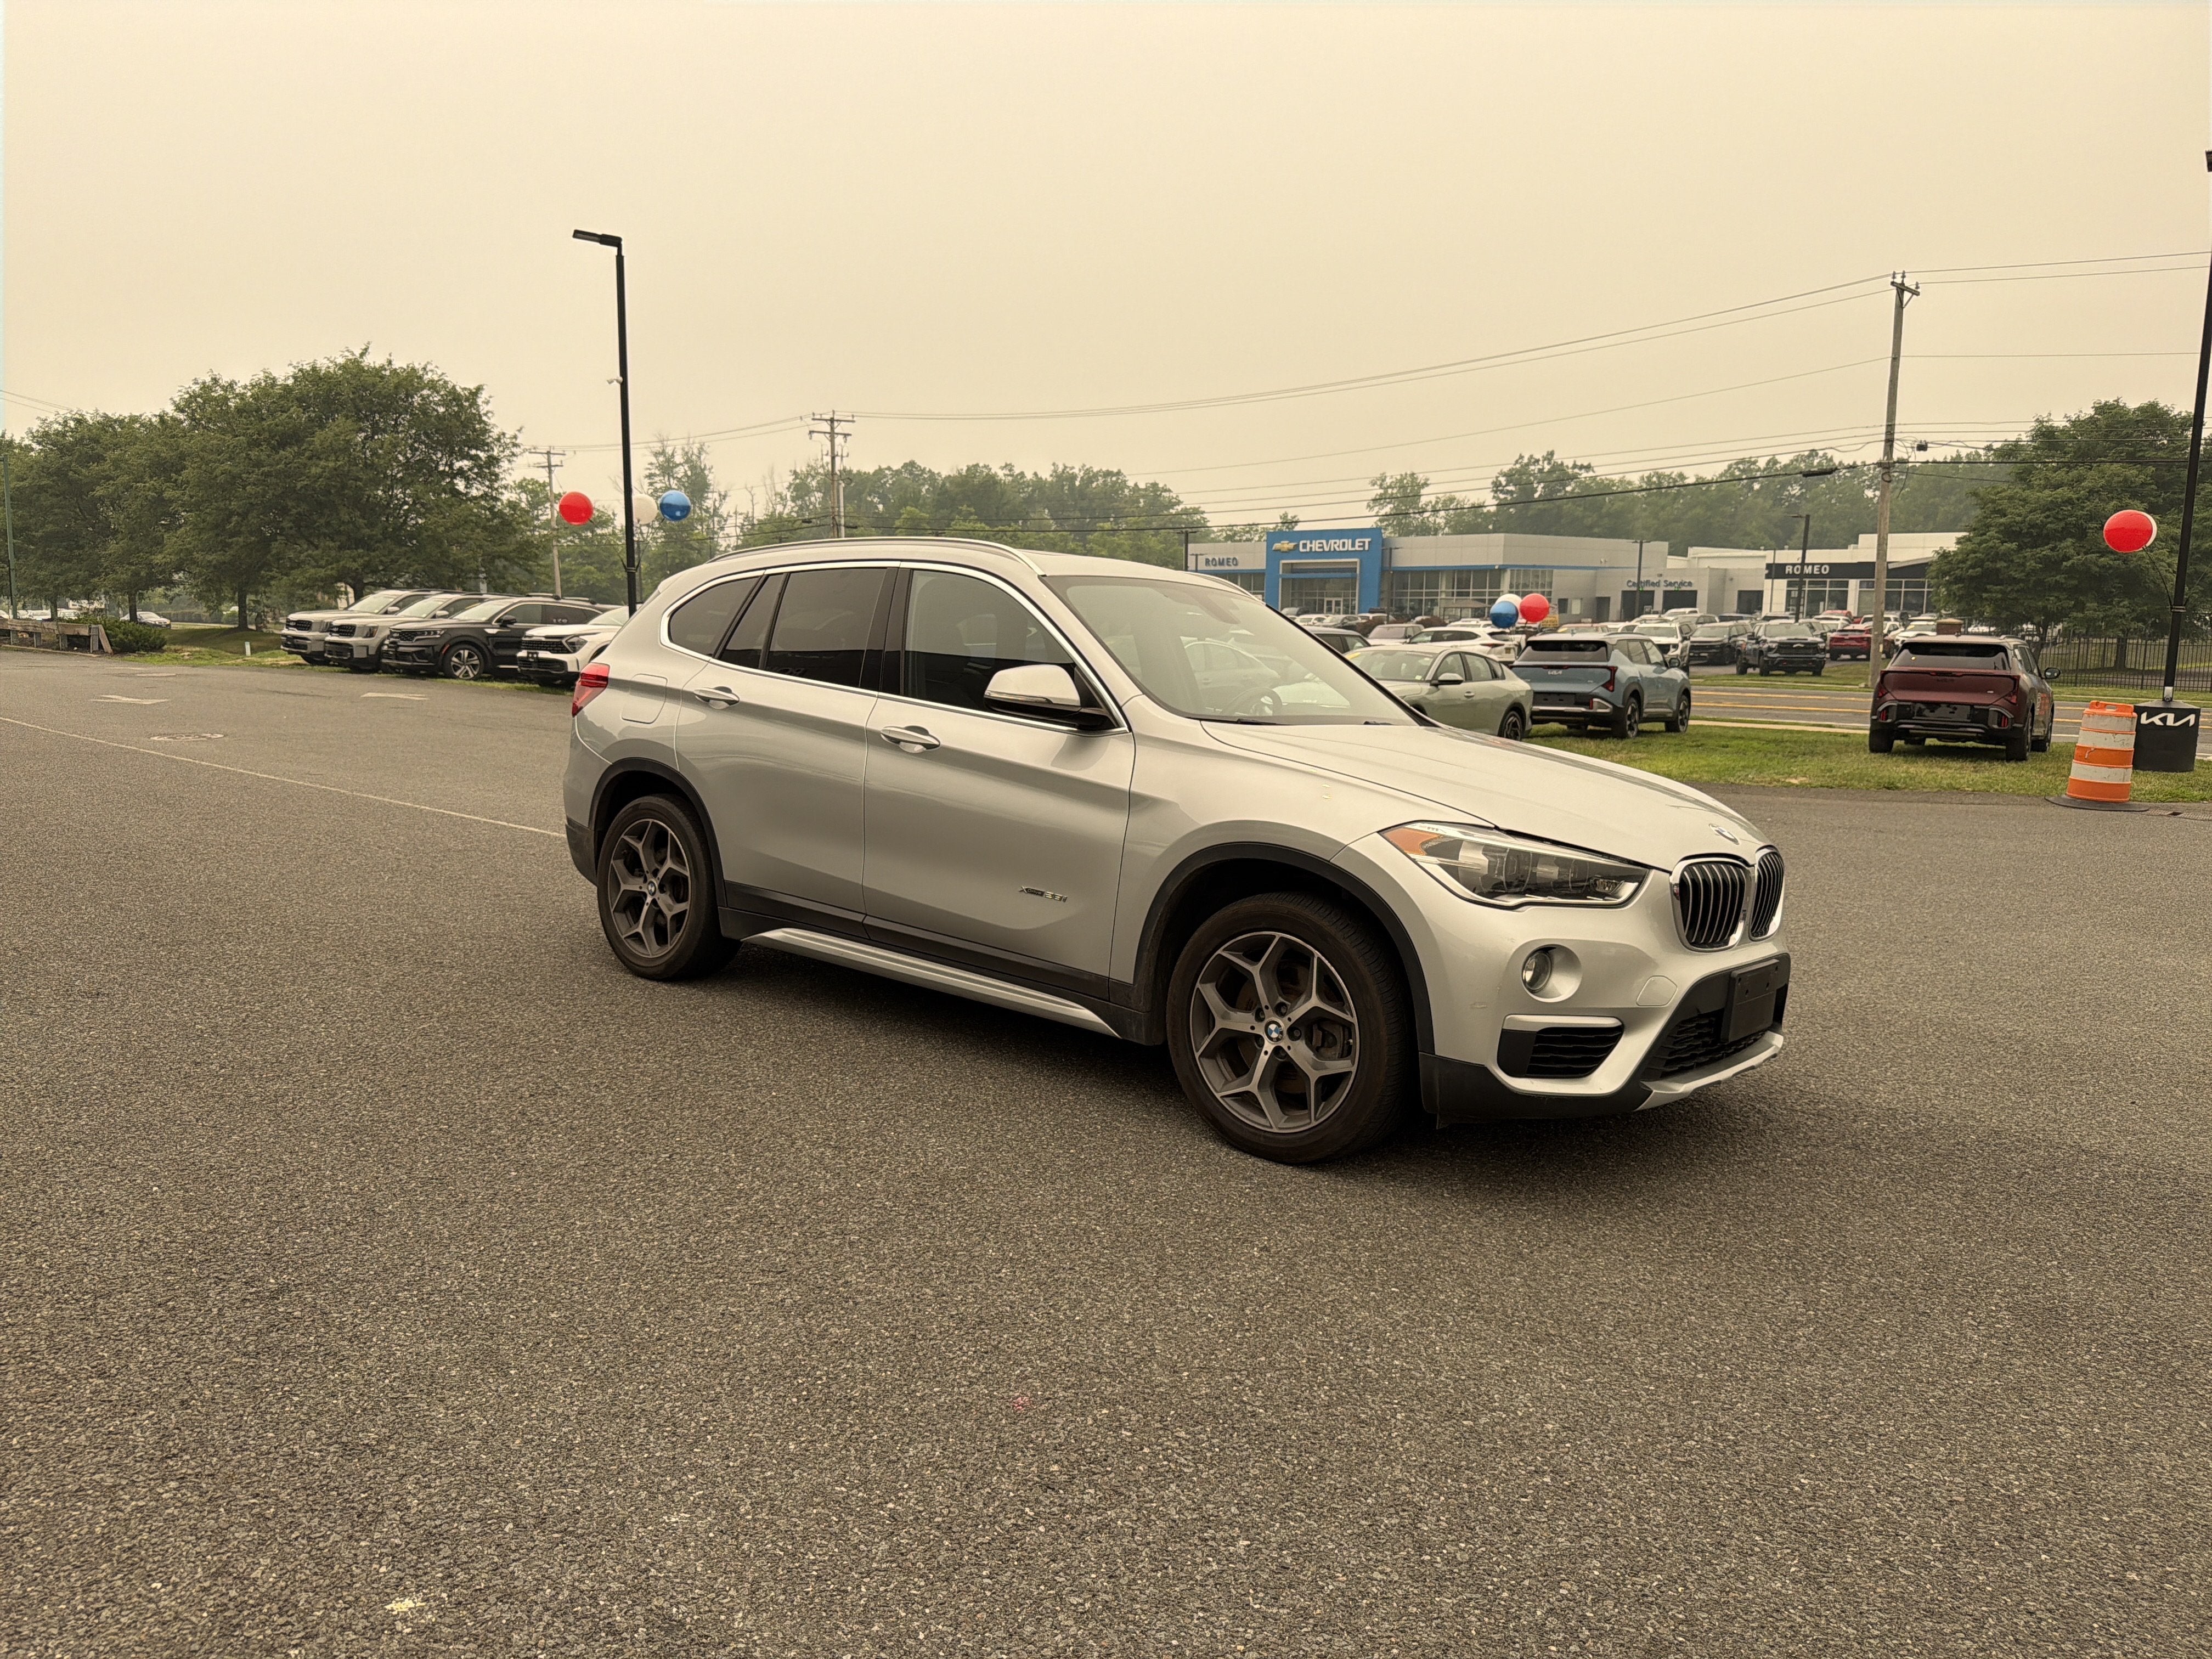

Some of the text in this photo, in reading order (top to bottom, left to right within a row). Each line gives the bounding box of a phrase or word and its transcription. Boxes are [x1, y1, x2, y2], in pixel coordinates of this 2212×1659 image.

[1299, 538, 1371, 552] CHEVROLET
[1205, 557, 1238, 566] ROMEO
[1785, 565, 1830, 574] ROMEO
[2141, 712, 2196, 727] KIA
